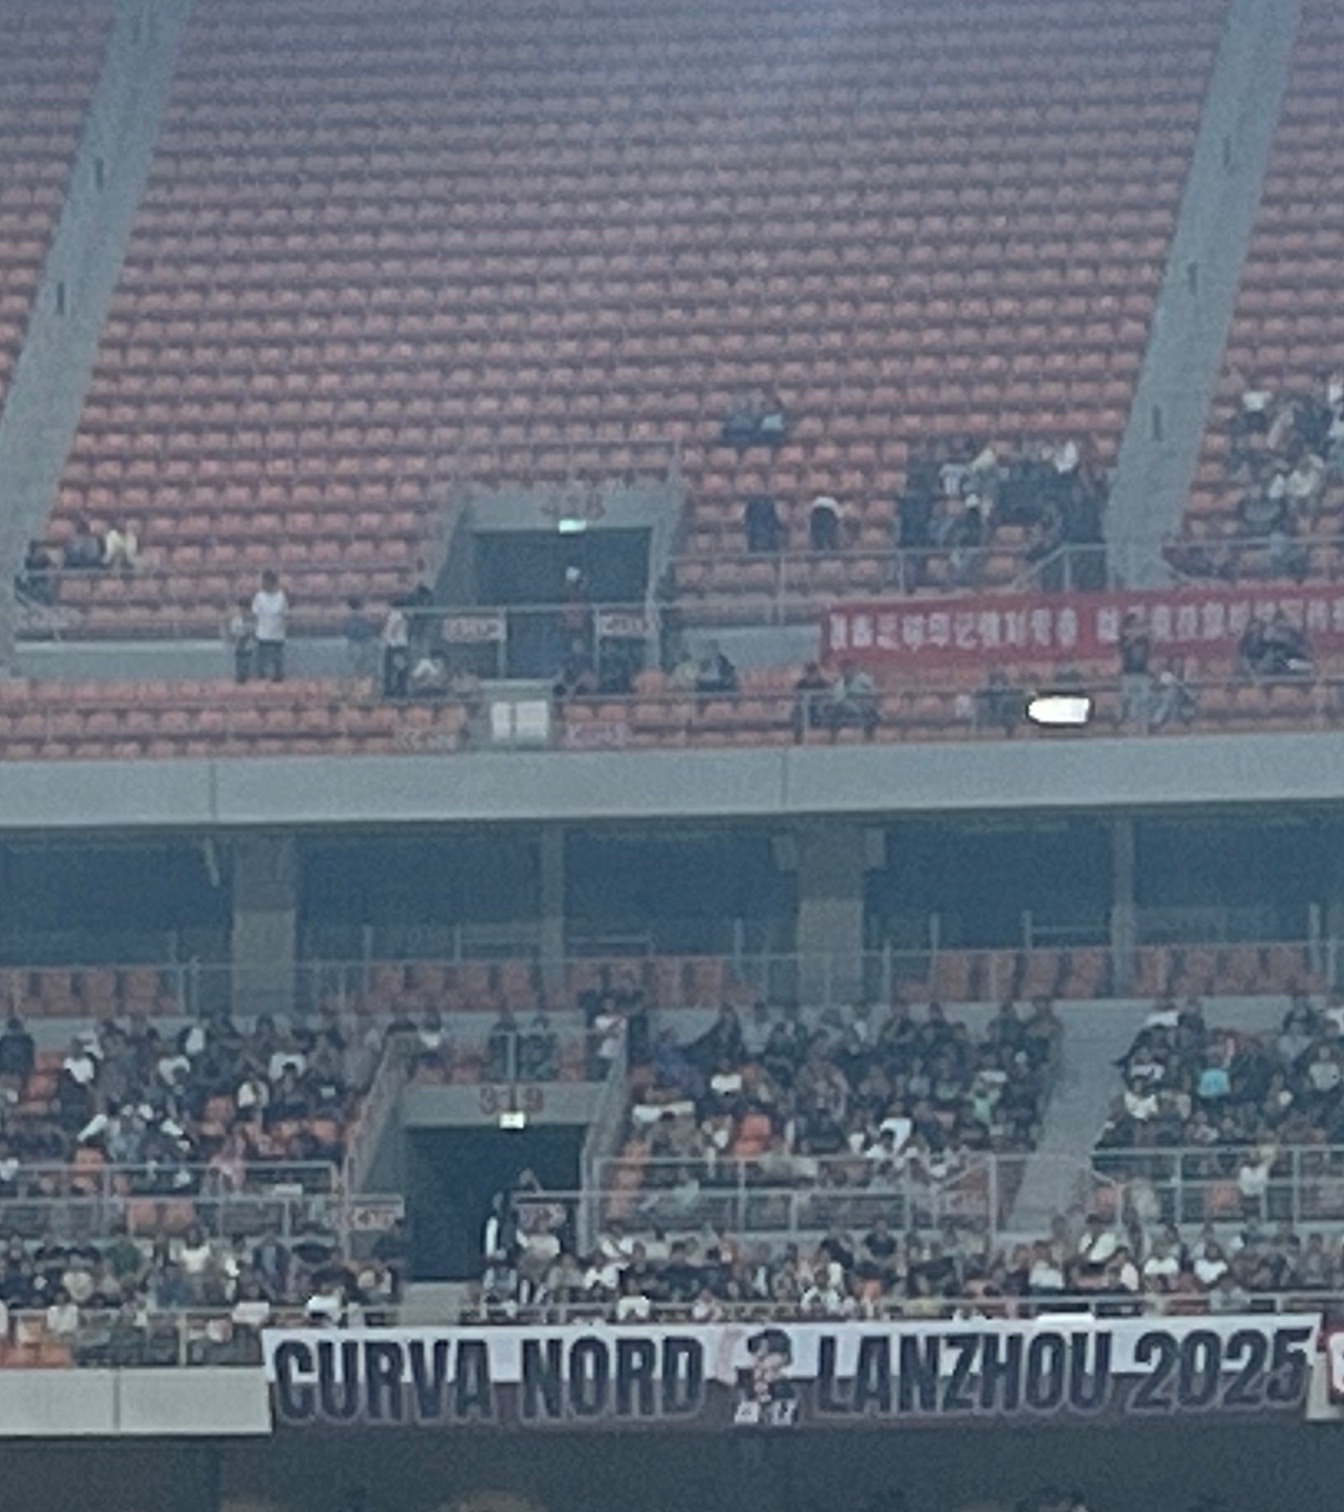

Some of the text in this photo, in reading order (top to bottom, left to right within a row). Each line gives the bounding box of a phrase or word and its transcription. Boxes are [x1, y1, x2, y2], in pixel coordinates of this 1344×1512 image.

[272, 1324, 1314, 1424] CURVA NORD LANZHOU 2025
